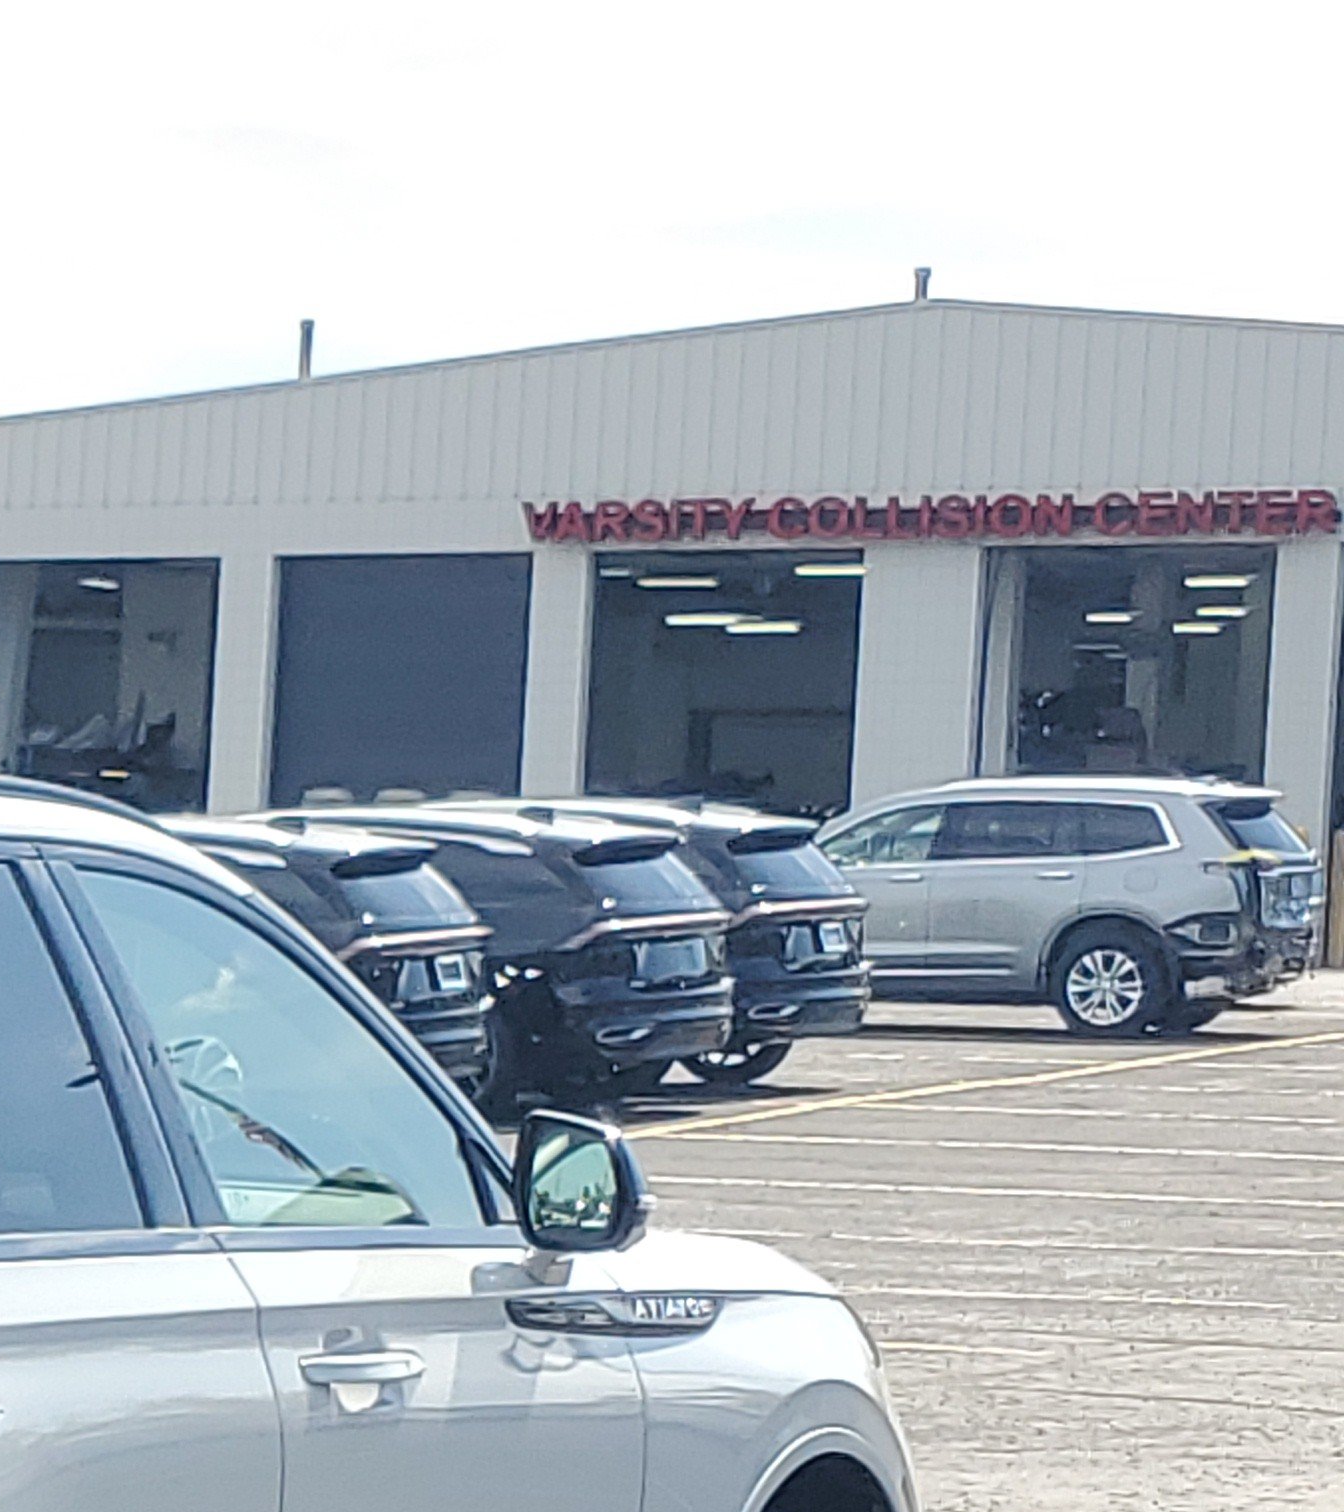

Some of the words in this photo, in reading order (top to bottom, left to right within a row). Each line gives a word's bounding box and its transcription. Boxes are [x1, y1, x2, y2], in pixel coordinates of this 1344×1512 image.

[521, 498, 755, 541] VARSITY
[766, 494, 1073, 540] COLLISION
[1095, 489, 1336, 537] CENTER
